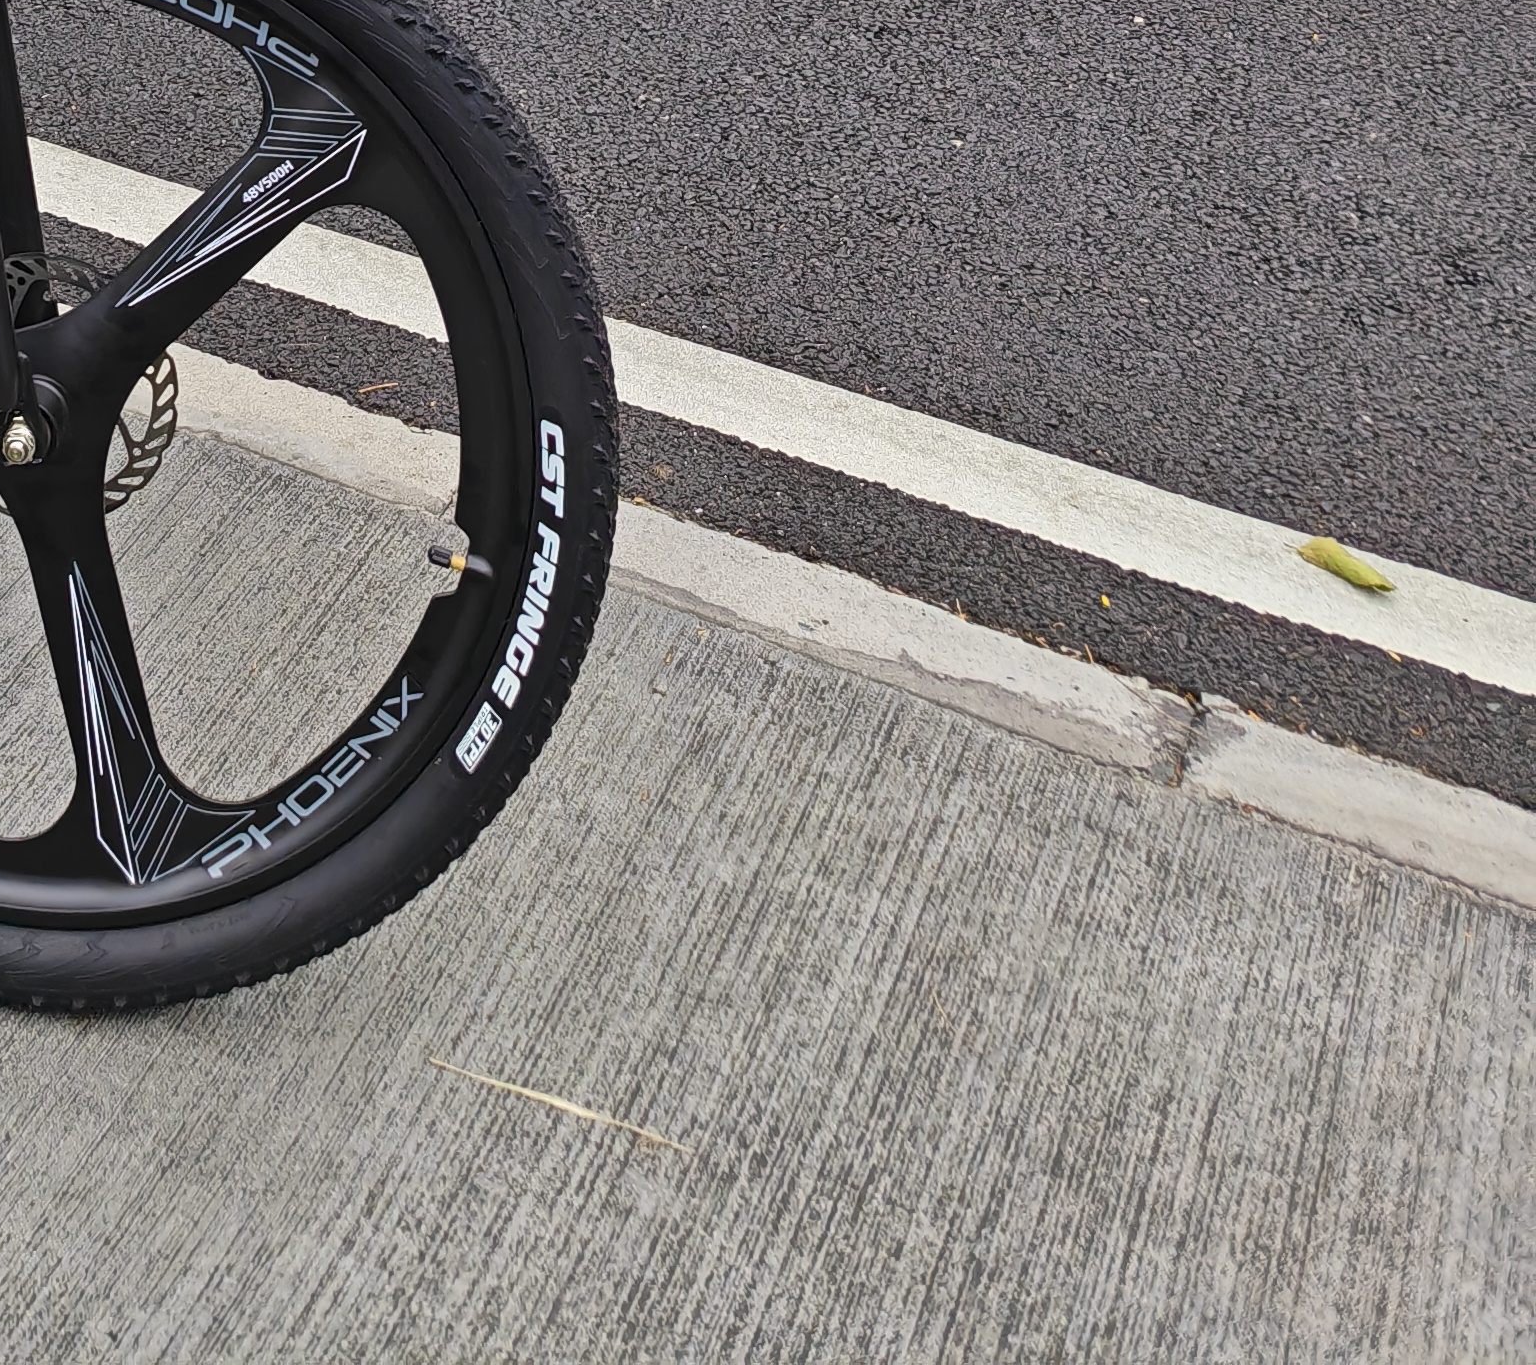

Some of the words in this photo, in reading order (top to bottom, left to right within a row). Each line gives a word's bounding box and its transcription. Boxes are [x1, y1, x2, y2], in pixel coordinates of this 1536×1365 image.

[240, 159, 295, 203] 48V500H
[539, 418, 565, 519] CST
[492, 521, 561, 710] FRINGE
[201, 675, 424, 879] PHOENIX
